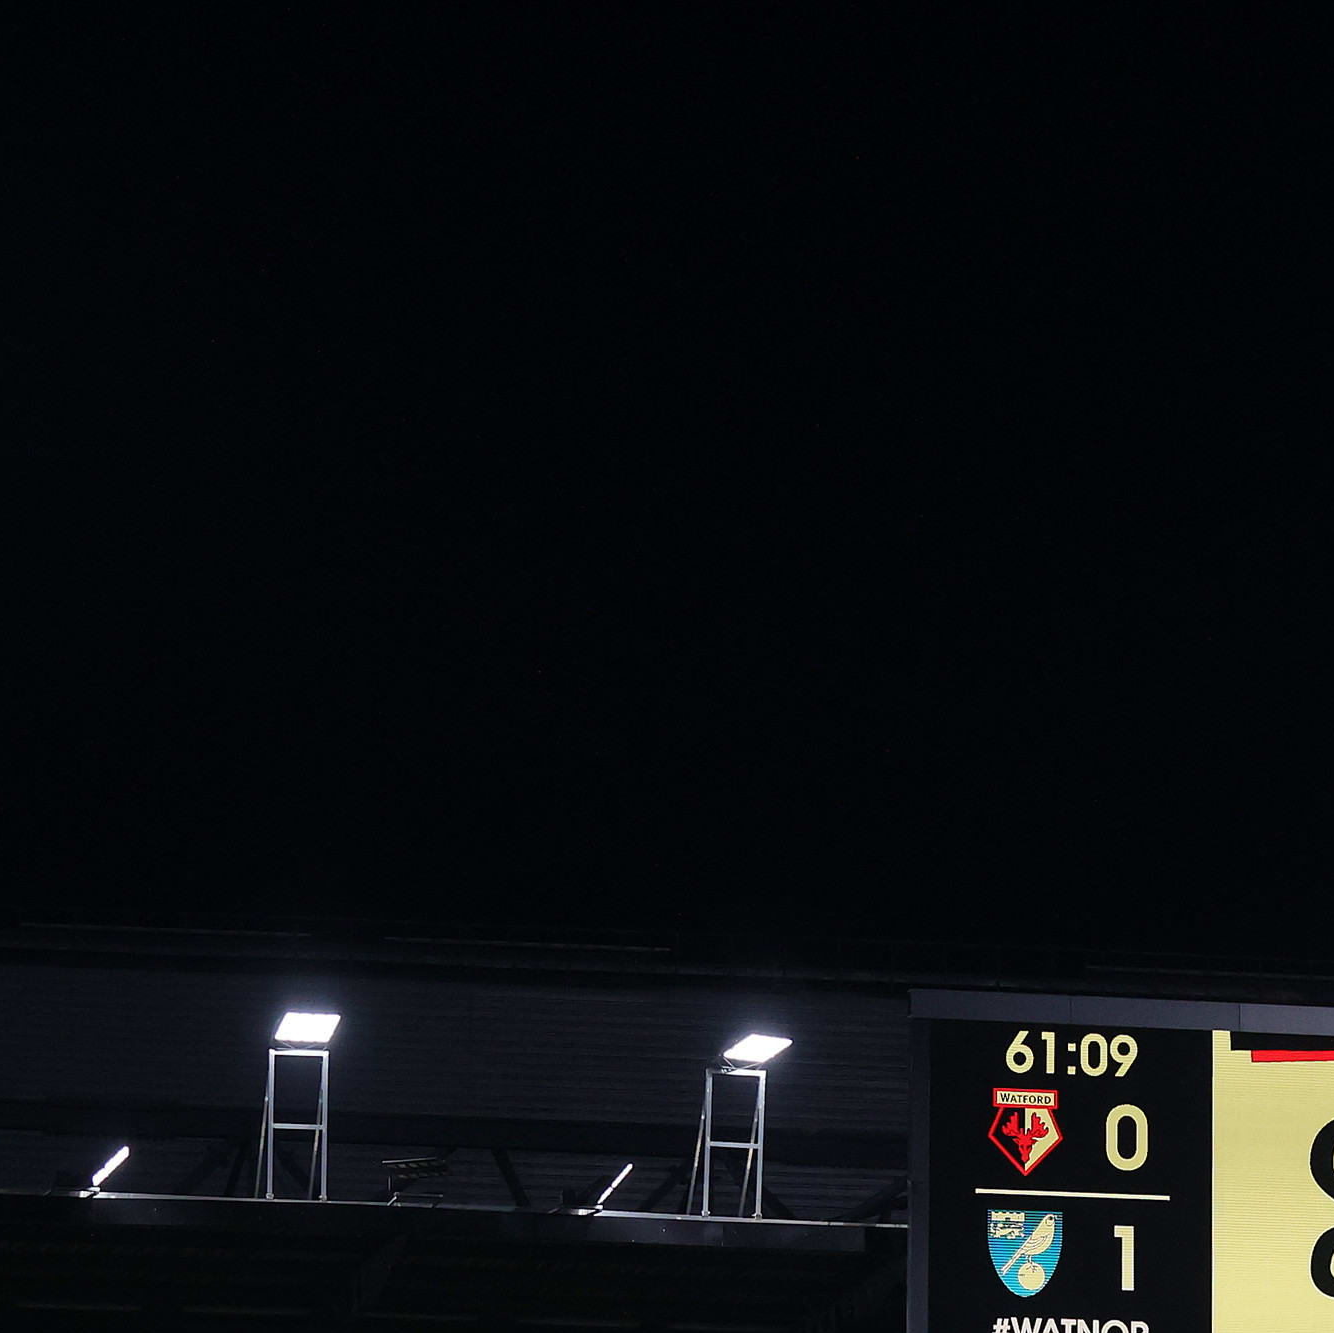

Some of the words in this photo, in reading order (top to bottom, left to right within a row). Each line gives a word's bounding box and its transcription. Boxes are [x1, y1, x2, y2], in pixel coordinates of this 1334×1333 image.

[1005, 1030, 1138, 1077] 61:09
[1000, 1092, 1052, 1105] WATFORD
[1105, 1104, 1149, 1171] 0
[1113, 1225, 1134, 1291] 1
